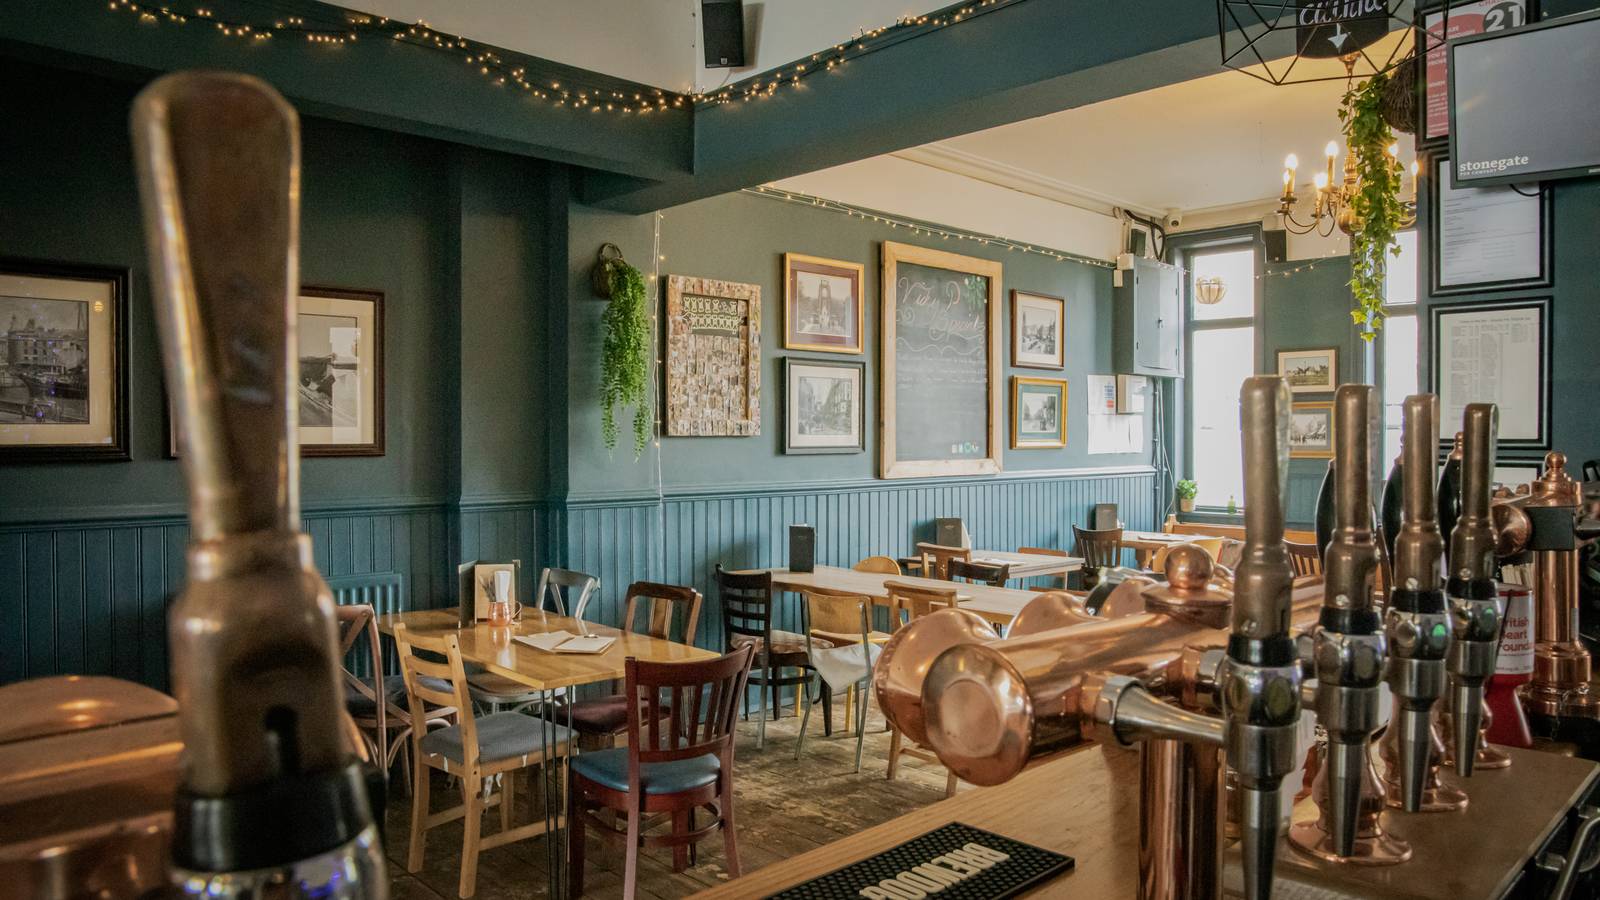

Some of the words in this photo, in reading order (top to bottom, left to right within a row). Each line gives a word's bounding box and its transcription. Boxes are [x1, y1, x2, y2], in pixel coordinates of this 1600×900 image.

[1485, 5, 1521, 32] 21
[1460, 155, 1529, 171] stonegate
[1503, 616, 1528, 628] ritish
